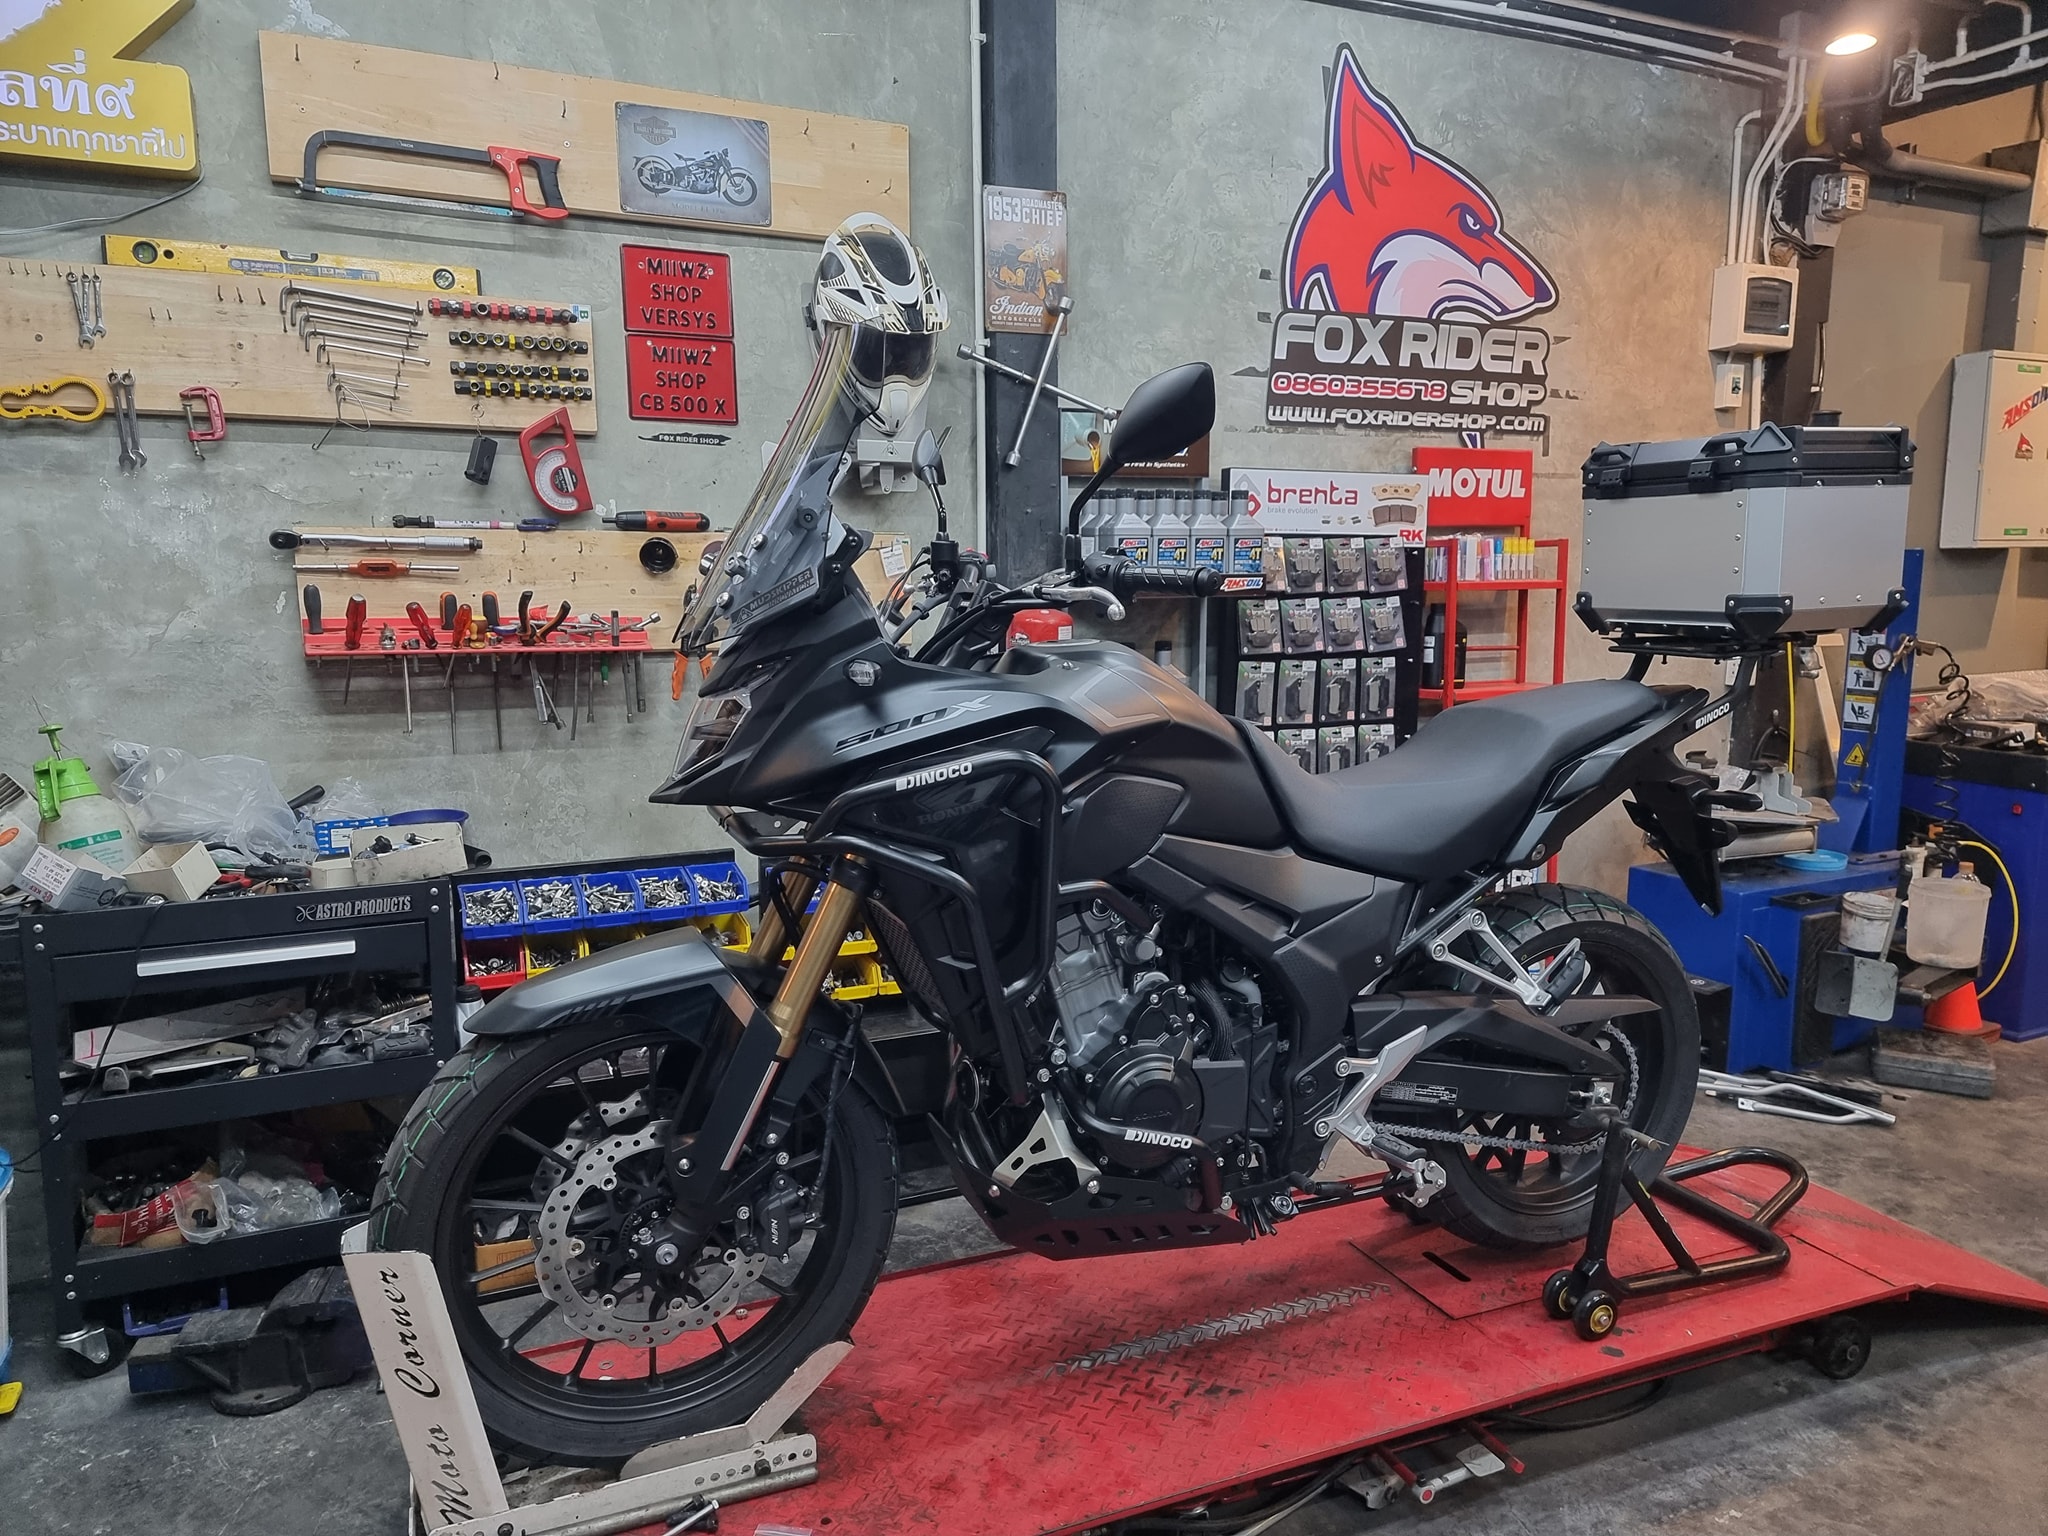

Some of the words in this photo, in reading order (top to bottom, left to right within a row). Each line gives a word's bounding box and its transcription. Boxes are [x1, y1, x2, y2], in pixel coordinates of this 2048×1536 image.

[988, 195, 1021, 222] 1953
[1022, 198, 1063, 211] ROADMASTER
[1022, 207, 1063, 226] CHIEF
[651, 283, 702, 303] SHOP
[990, 296, 1043, 316] Indian
[640, 306, 717, 329] VERSYS
[992, 315, 1042, 323] MOTORCYCLE
[1274, 313, 1395, 366] FOX
[1399, 321, 1549, 375] RIDER
[656, 370, 706, 389] SHOP
[1272, 372, 1448, 401] 0860355678
[1449, 380, 1545, 407] SHOP
[640, 393, 665, 411] CB
[670, 395, 708, 413] 500
[714, 398, 726, 415] X
[659, 434, 675, 442] FOX
[700, 437, 720, 445] SHOP
[1267, 478, 1359, 506] brenta
[1428, 468, 1526, 498] MOTUL
[1267, 506, 1290, 514] brake
[1292, 506, 1318, 515] evolution
[1400, 529, 1424, 542] RK
[1135, 548, 1148, 561] 4T
[1174, 548, 1187, 561] 4T
[1211, 548, 1224, 561] 4T
[1250, 548, 1262, 561] 4T
[749, 570, 811, 611] MUDSKIPPER
[1223, 577, 1264, 591] AMSOIL
[832, 694, 993, 757] 500X
[1695, 702, 1730, 730] DINOCO
[896, 761, 973, 791] DINOCO
[316, 902, 352, 920] ASTRO
[354, 896, 411, 915] PRODUCTS
[1124, 1129, 1193, 1149] DINOCO
[379, 1266, 441, 1399] Corner
[426, 1424, 475, 1525] Moto
